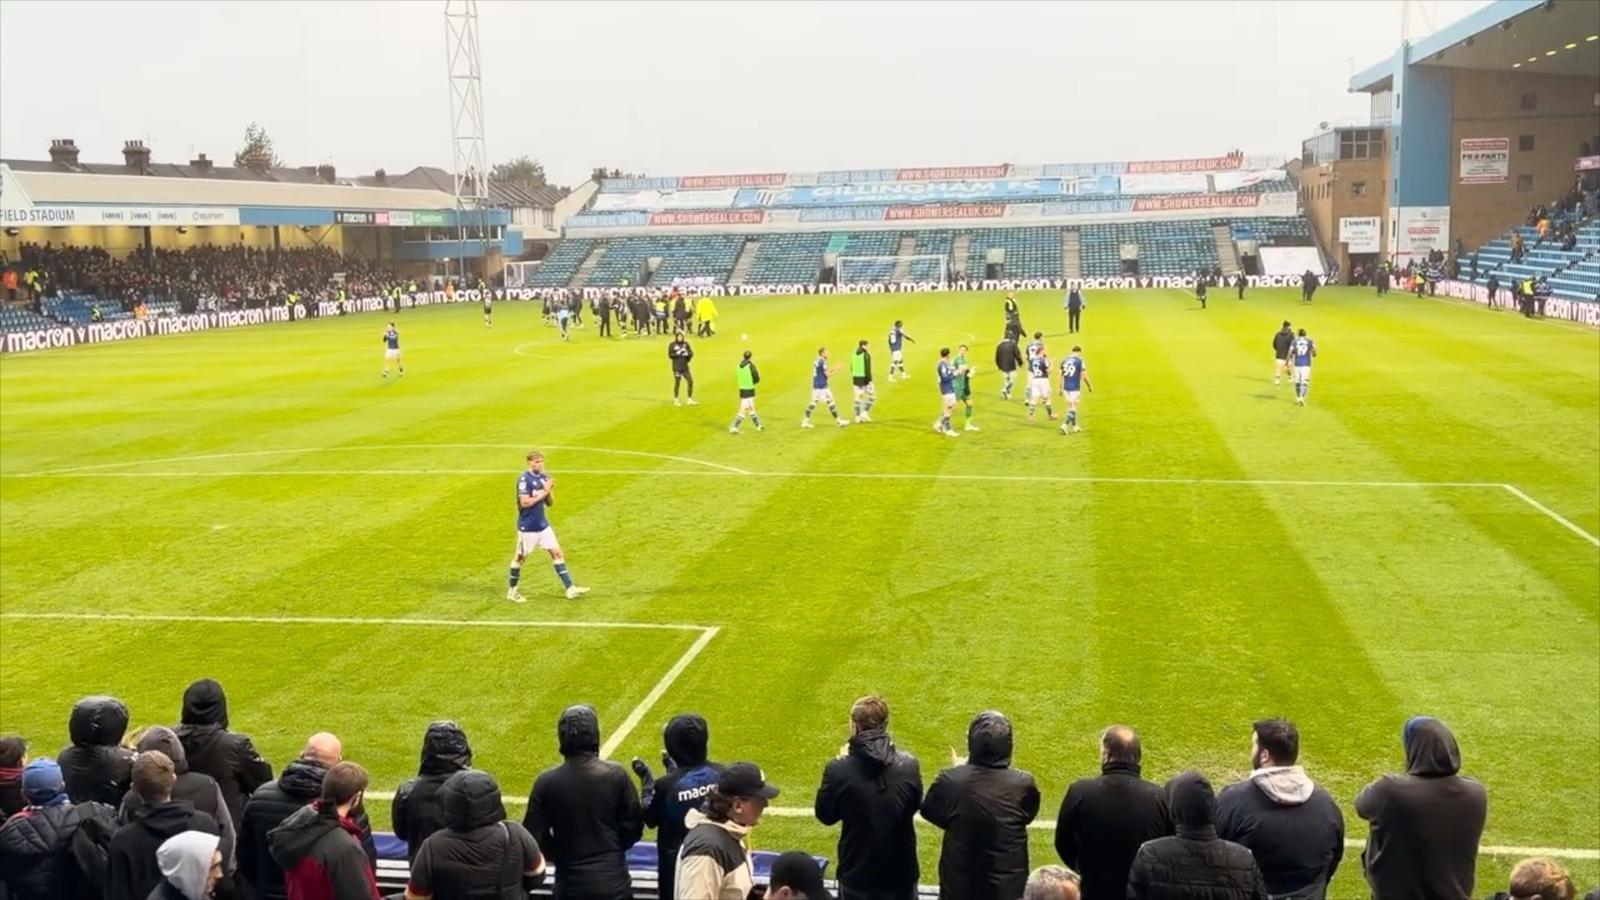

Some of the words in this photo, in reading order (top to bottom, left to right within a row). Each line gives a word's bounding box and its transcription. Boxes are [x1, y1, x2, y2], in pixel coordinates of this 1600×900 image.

[812, 181, 997, 197] GILLINGHAM
[1137, 195, 1256, 210] WWW.SHOWERSEALUK.COM
[29, 209, 75, 221] STADIUM
[654, 212, 760, 224] WWW.SHOWERSEALUK.COM
[890, 205, 1001, 218] WWW.SHOWERSEALUK.COM
[740, 283, 804, 295] macron
[820, 282, 884, 294] macron
[983, 279, 1050, 291] macron
[1067, 277, 1136, 290] macron
[320, 299, 356, 316] macon
[158, 313, 209, 335] macron
[219, 308, 264, 328] macron
[88, 320, 146, 343] macron
[7, 327, 75, 352] macron
